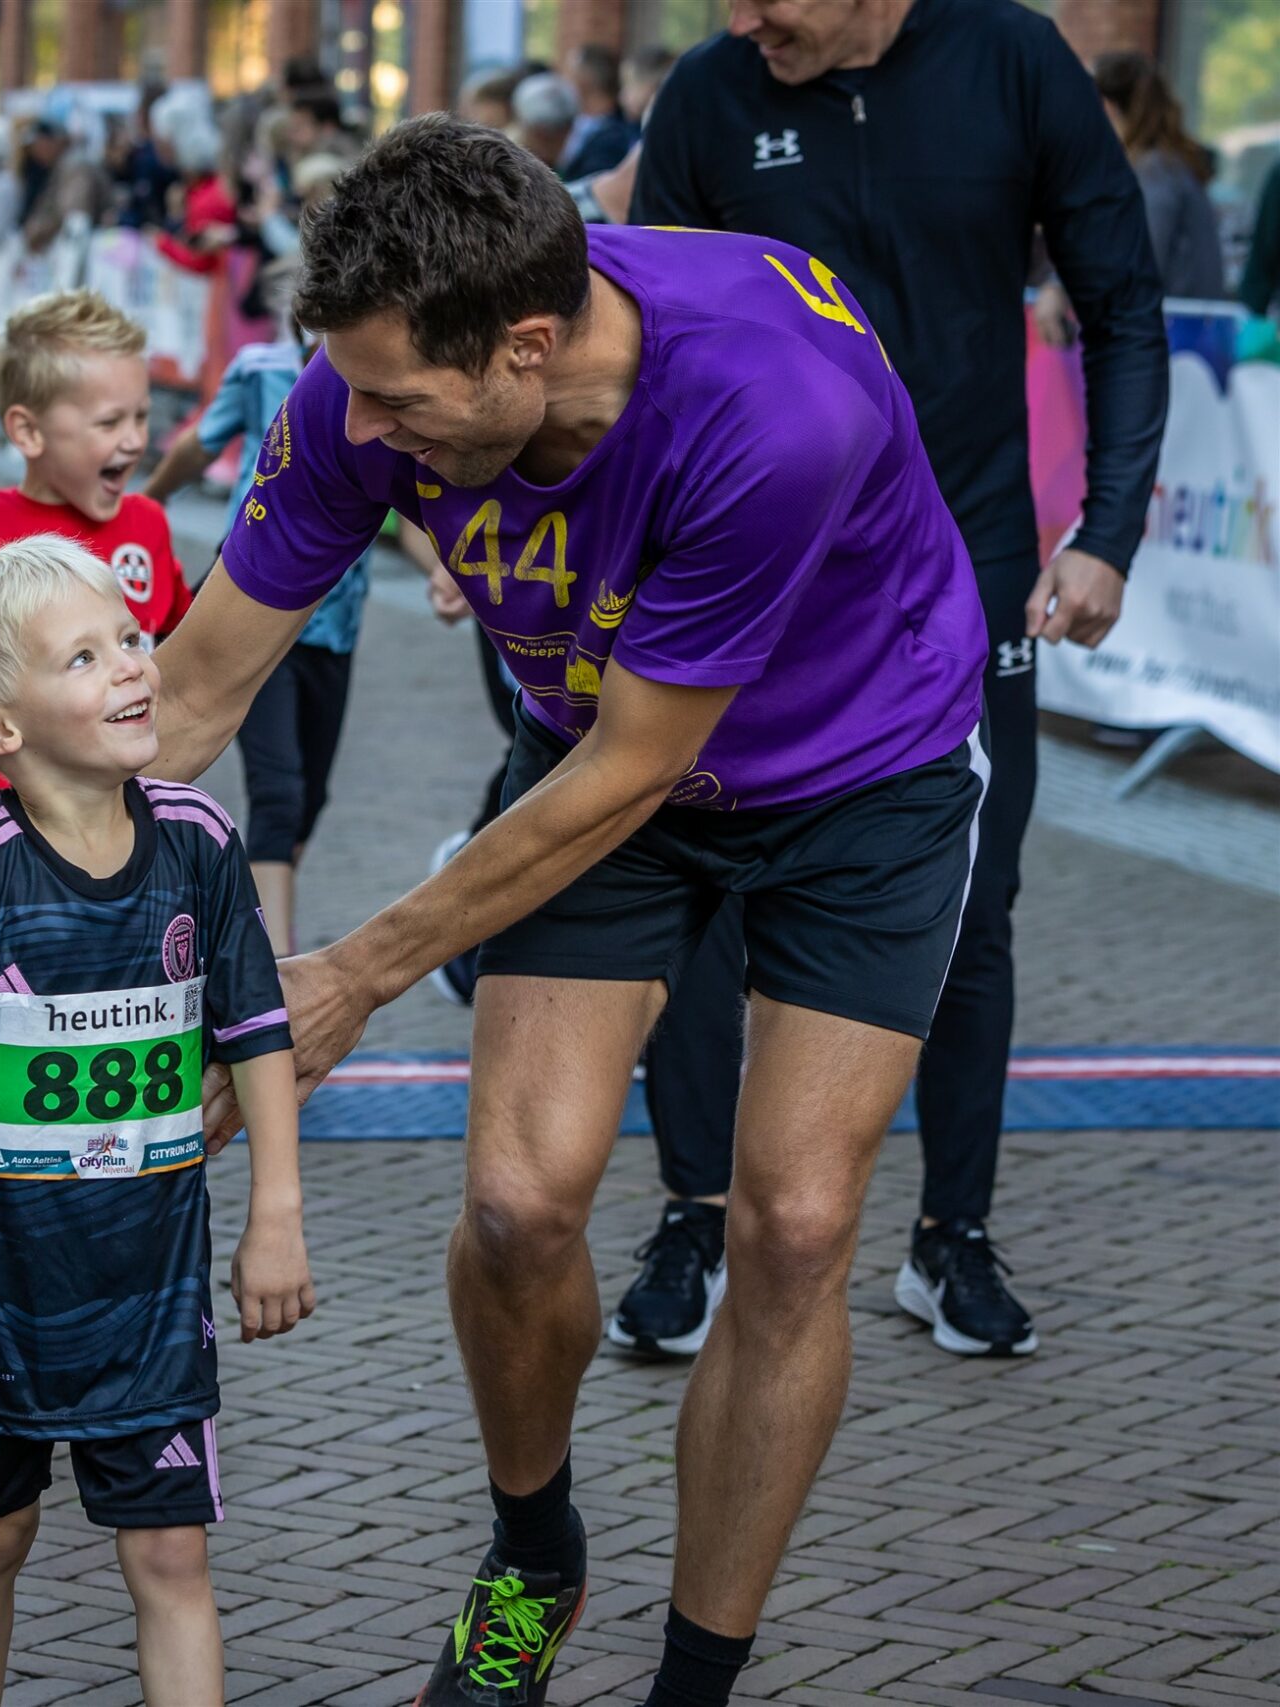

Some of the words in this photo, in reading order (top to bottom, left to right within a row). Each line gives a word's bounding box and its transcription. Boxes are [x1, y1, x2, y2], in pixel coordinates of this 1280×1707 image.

[417, 480, 577, 608] 44
[506, 639, 566, 658] Wesepe
[45, 996, 175, 1032] heutink.
[23, 1040, 184, 1122] 888
[11, 1156, 31, 1164] Auto
[149, 1147, 185, 1160] CITYRUN
[79, 1155, 126, 1169] CityRun
[102, 1164, 135, 1174] Nijverdal
